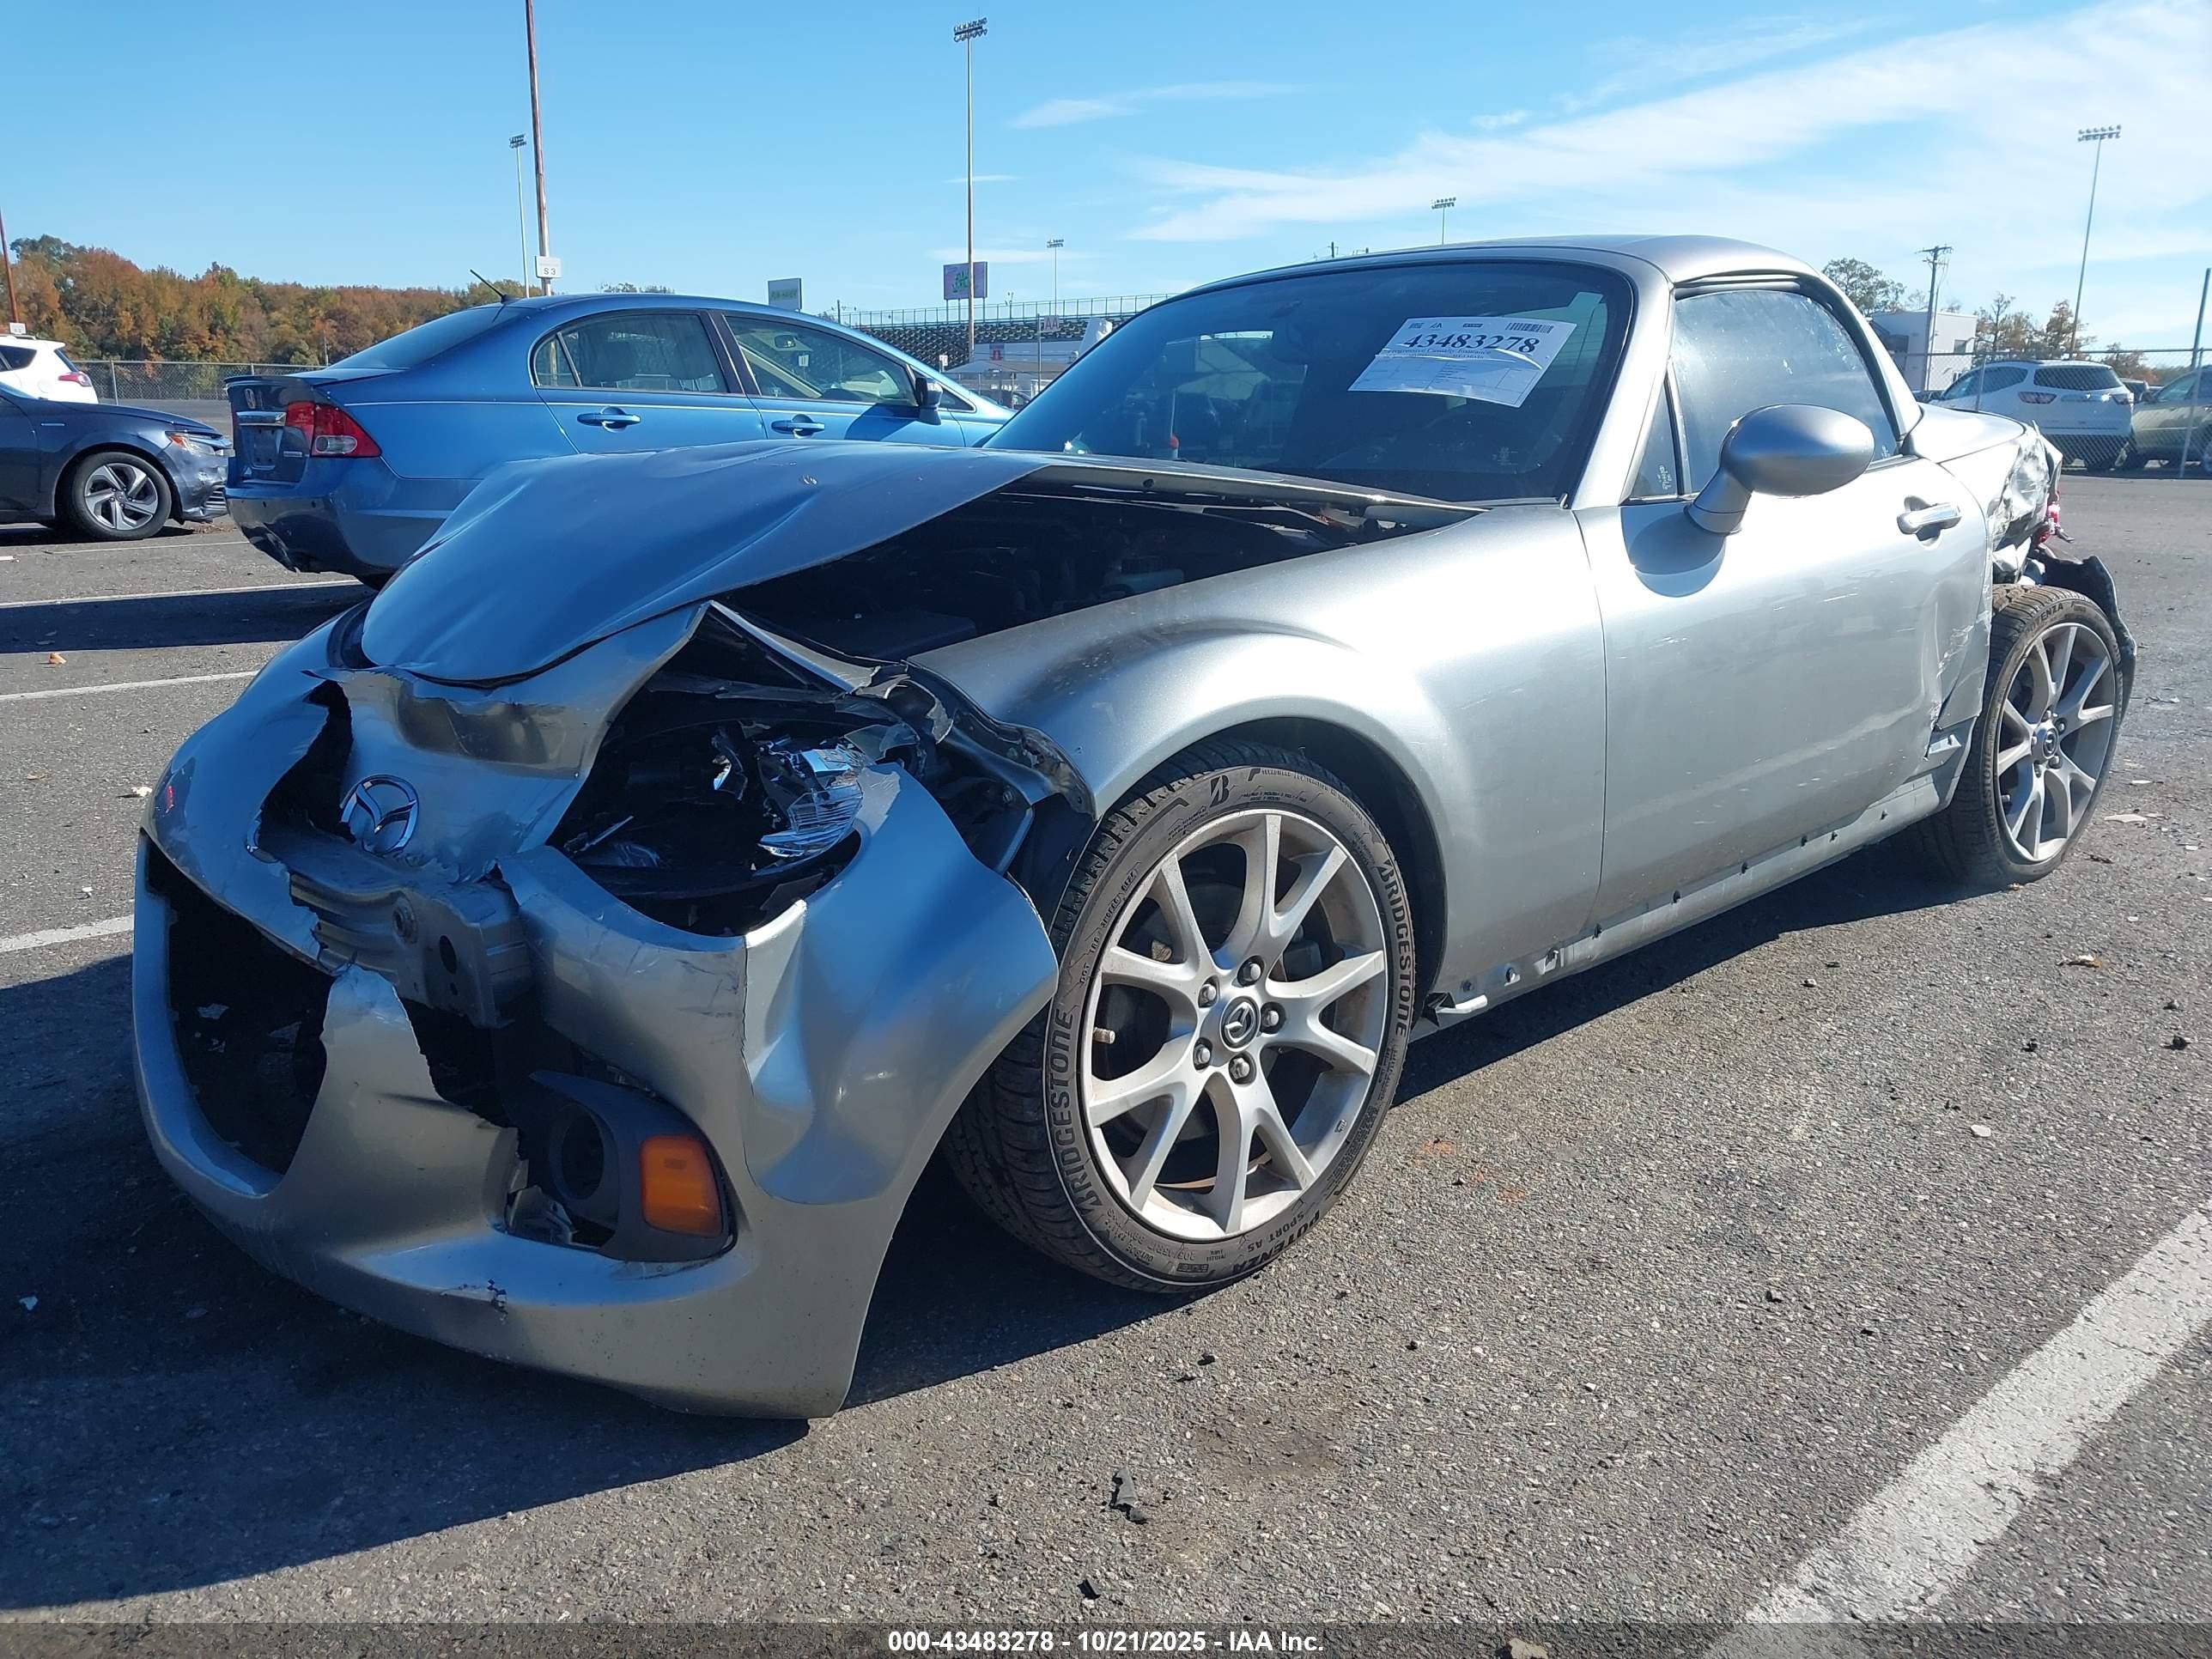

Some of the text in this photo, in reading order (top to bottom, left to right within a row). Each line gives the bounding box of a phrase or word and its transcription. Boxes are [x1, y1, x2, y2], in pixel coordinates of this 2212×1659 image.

[1404, 333, 1540, 354] 43483278
[1375, 858, 1413, 1037] BRIDGESTONE
[1049, 1007, 1103, 1216] BRIDGESTONE
[1232, 1210, 1320, 1273] POTENZA
[1248, 1211, 1304, 1252] SPORT AS
